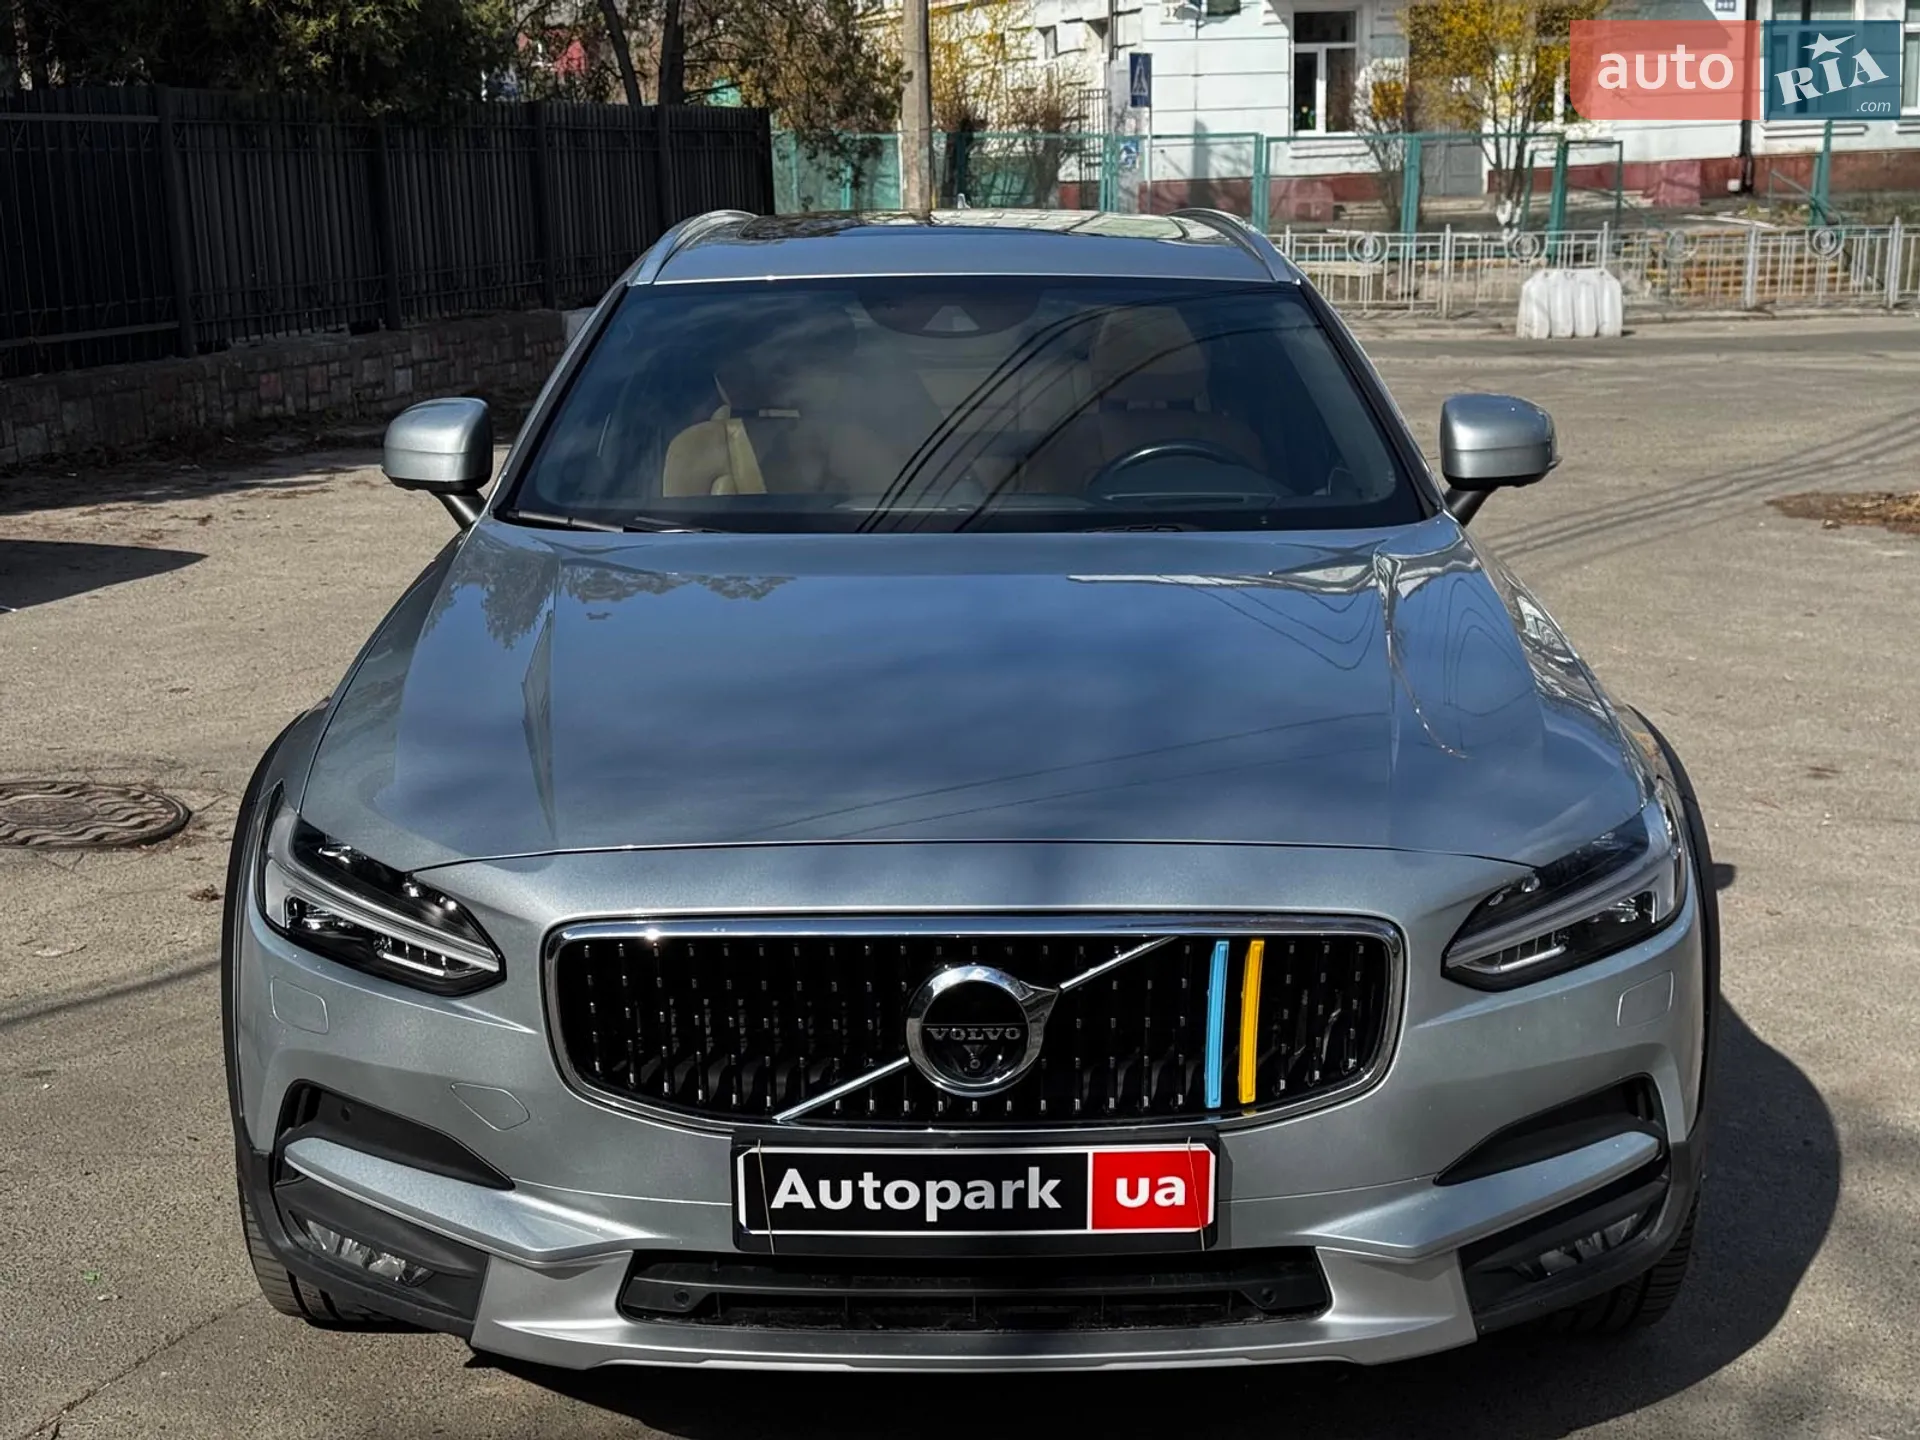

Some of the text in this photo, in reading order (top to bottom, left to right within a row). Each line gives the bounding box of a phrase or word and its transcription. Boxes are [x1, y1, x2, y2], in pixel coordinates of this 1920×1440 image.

[926, 1027, 1021, 1040] VOLVO
[770, 1167, 1186, 1222] Autopark ua
